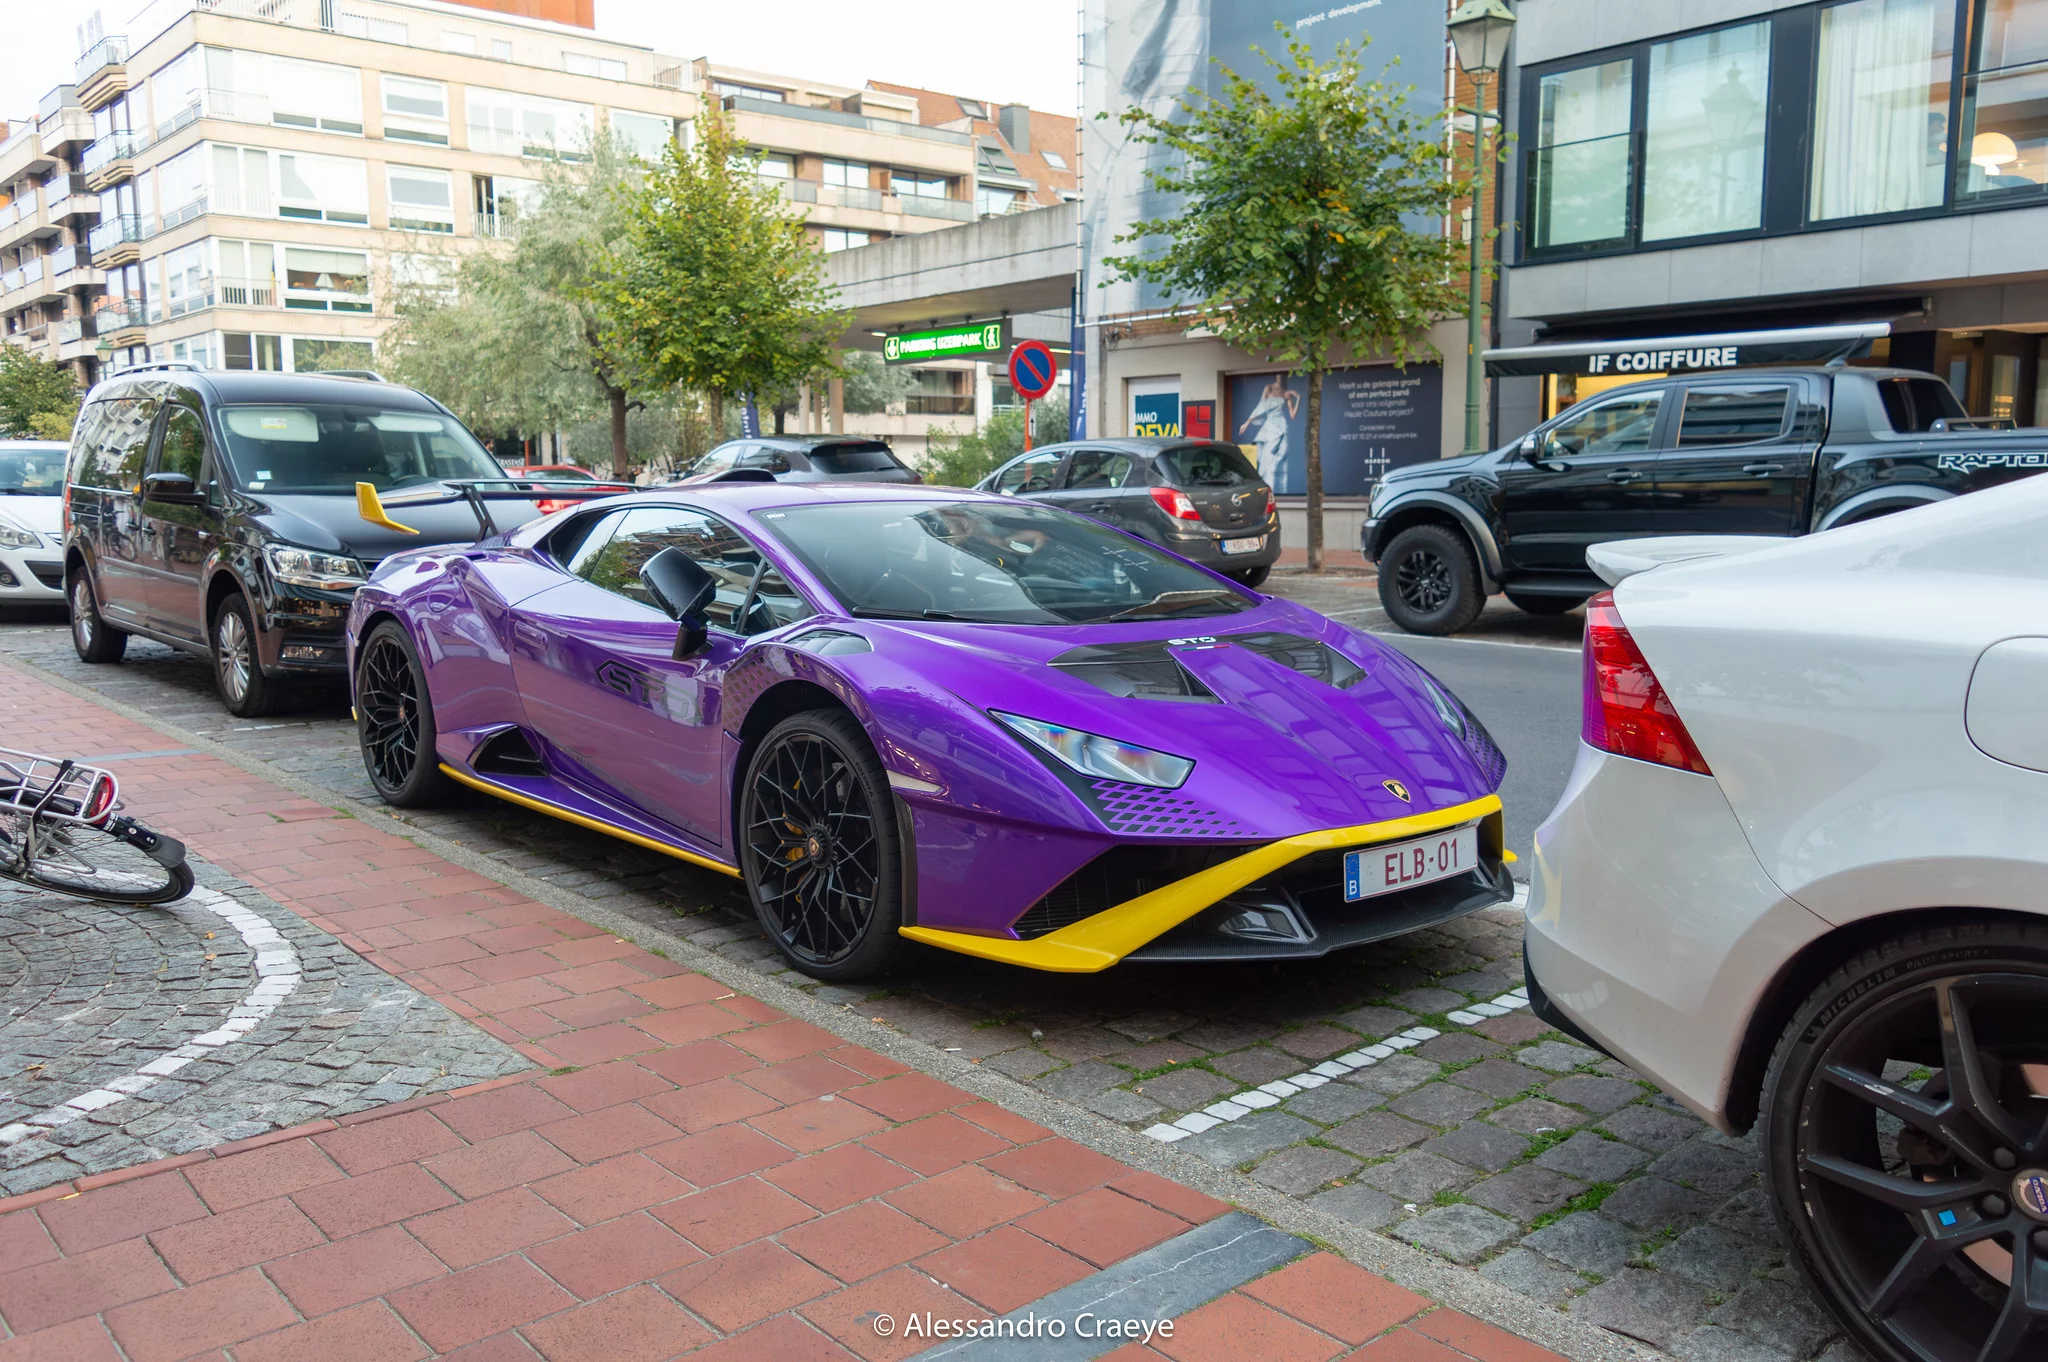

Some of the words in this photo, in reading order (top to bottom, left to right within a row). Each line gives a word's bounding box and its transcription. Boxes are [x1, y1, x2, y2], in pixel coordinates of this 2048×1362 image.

[1296, 12, 1325, 30] project
[1328, 0, 1381, 18] development
[900, 338, 936, 353] PARKING
[1589, 355, 1611, 373] IF
[1616, 347, 1738, 371] COIFFURE
[1348, 391, 1356, 399] of
[1369, 390, 1393, 399] perfect
[1393, 389, 1410, 397] pand
[1362, 409, 1388, 417] Couture
[1388, 408, 1415, 418] project?
[1385, 837, 1458, 886] ELB-01
[1349, 879, 1358, 895] B
[1820, 966, 1896, 1025] MICHELIN
